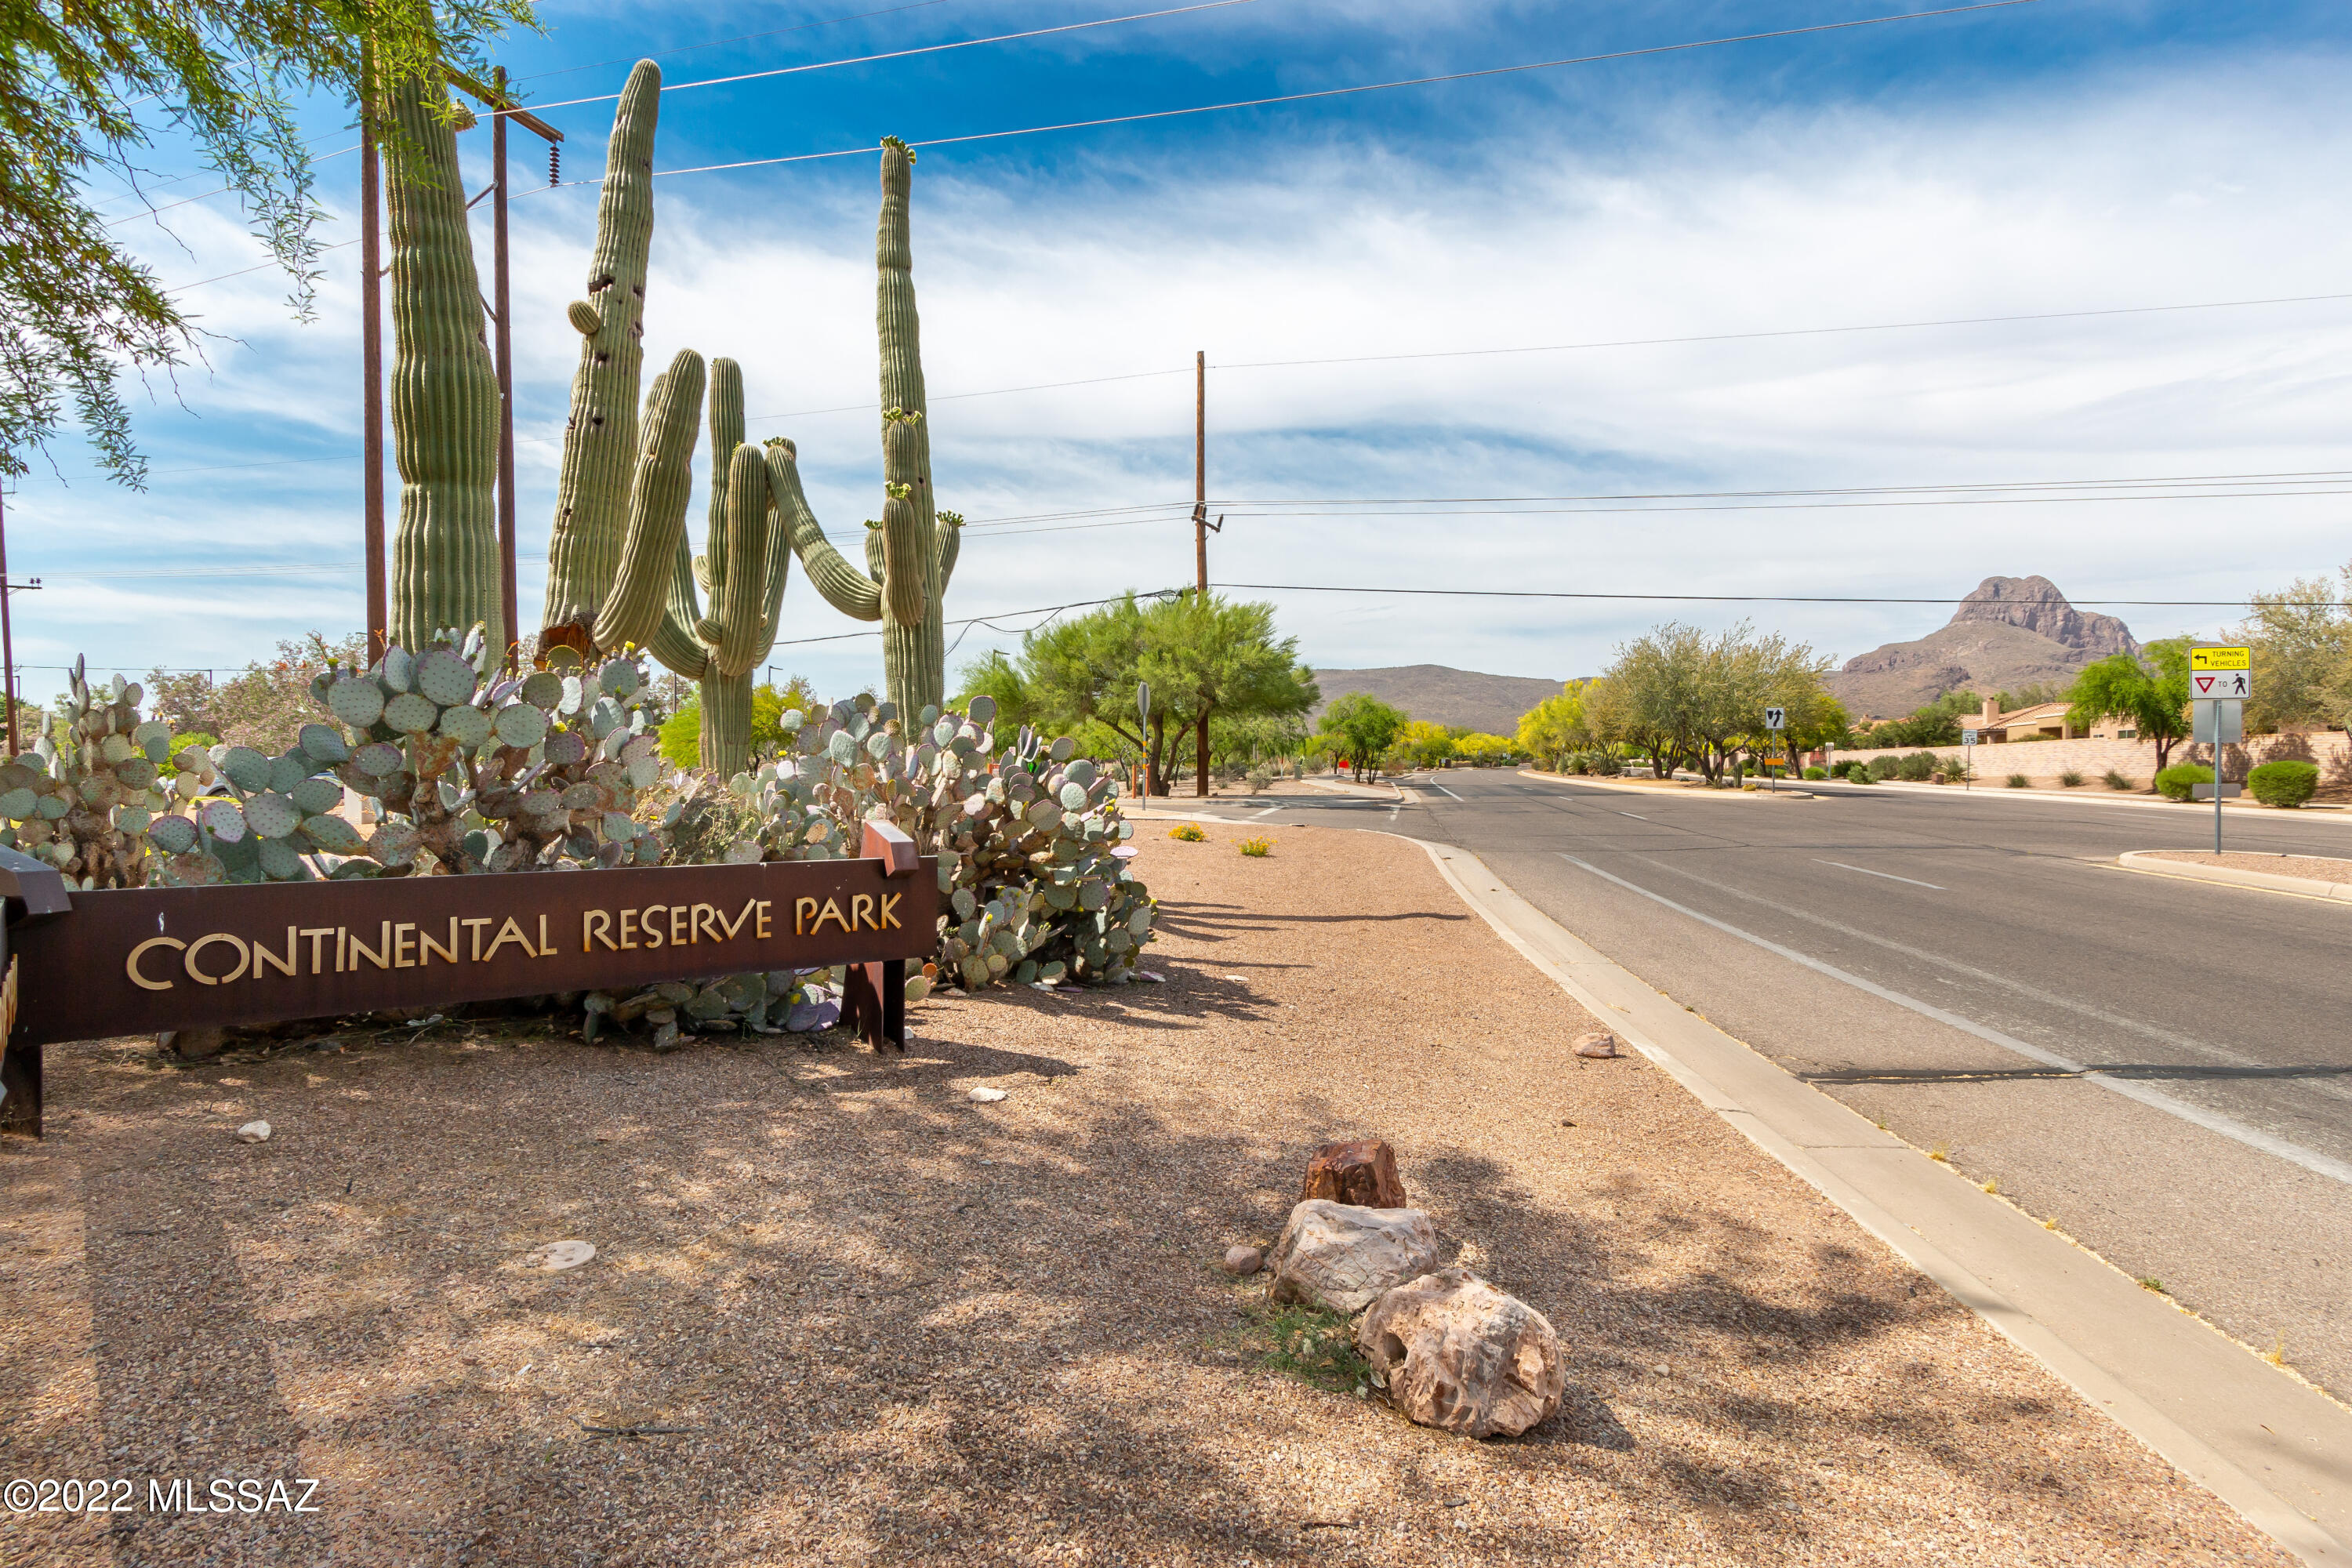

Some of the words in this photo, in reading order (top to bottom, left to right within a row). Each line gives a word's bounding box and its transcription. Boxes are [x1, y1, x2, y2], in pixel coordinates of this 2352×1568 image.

[126, 913, 557, 990] CONTINENTAL
[583, 898, 771, 953] RESERVE
[796, 891, 902, 935] PARK
